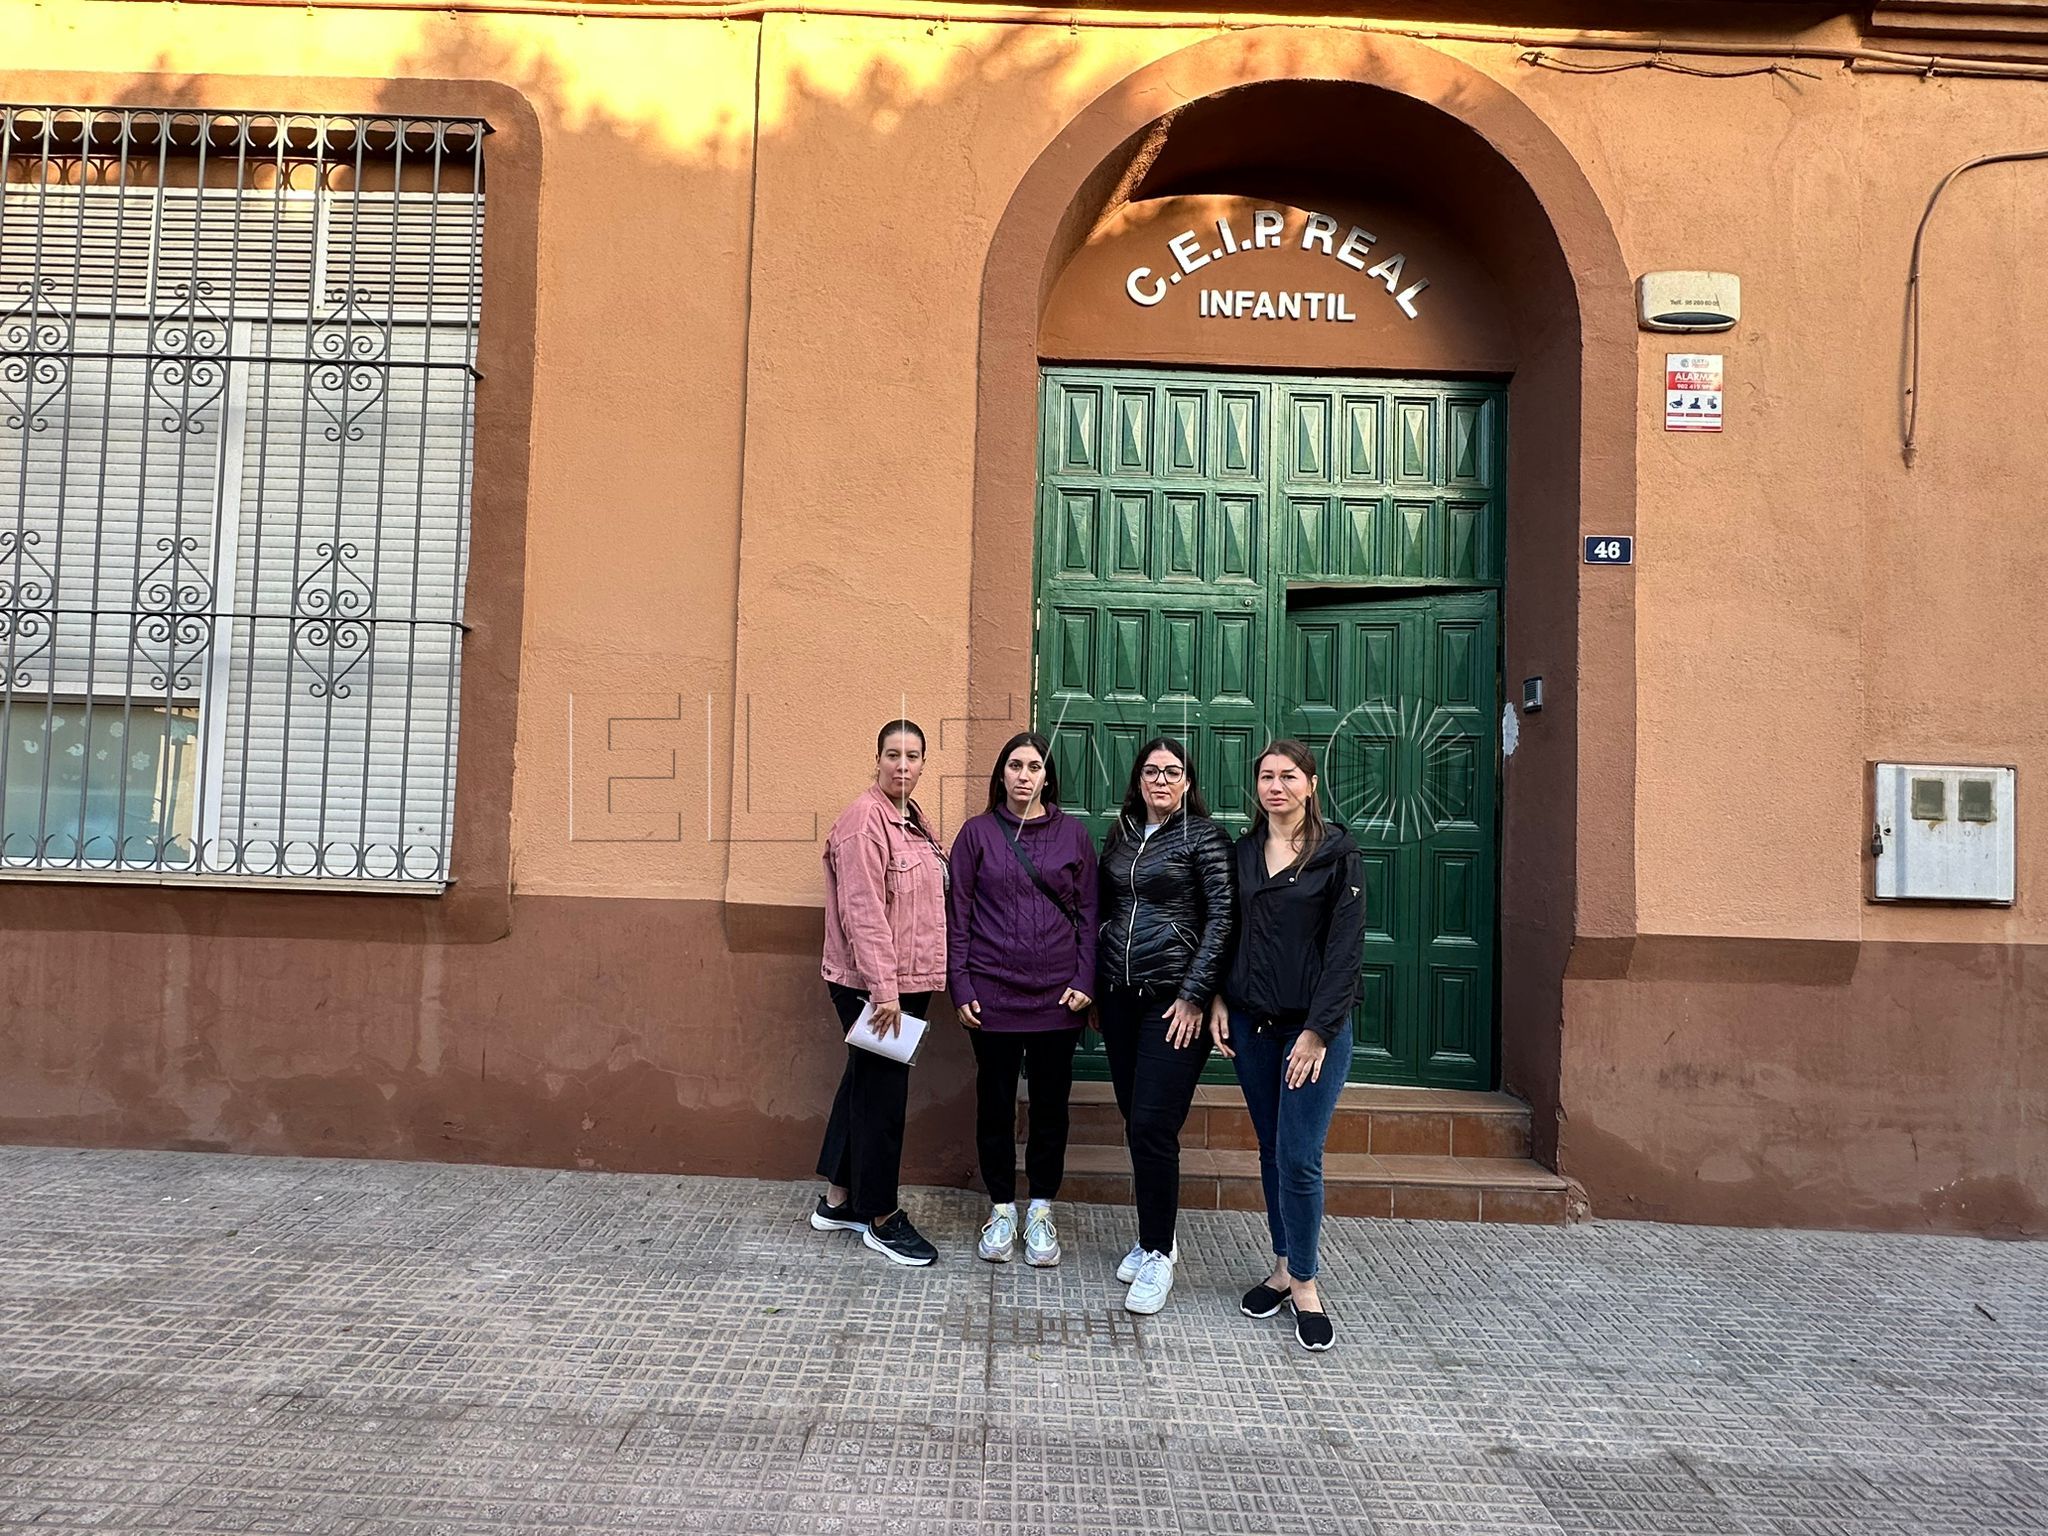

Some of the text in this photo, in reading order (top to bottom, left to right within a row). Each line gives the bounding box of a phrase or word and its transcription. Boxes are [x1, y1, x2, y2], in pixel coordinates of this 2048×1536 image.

[1301, 211, 1430, 320] REAL
[1199, 288, 1357, 321] INFANTIL
[1593, 540, 1621, 560] 46
